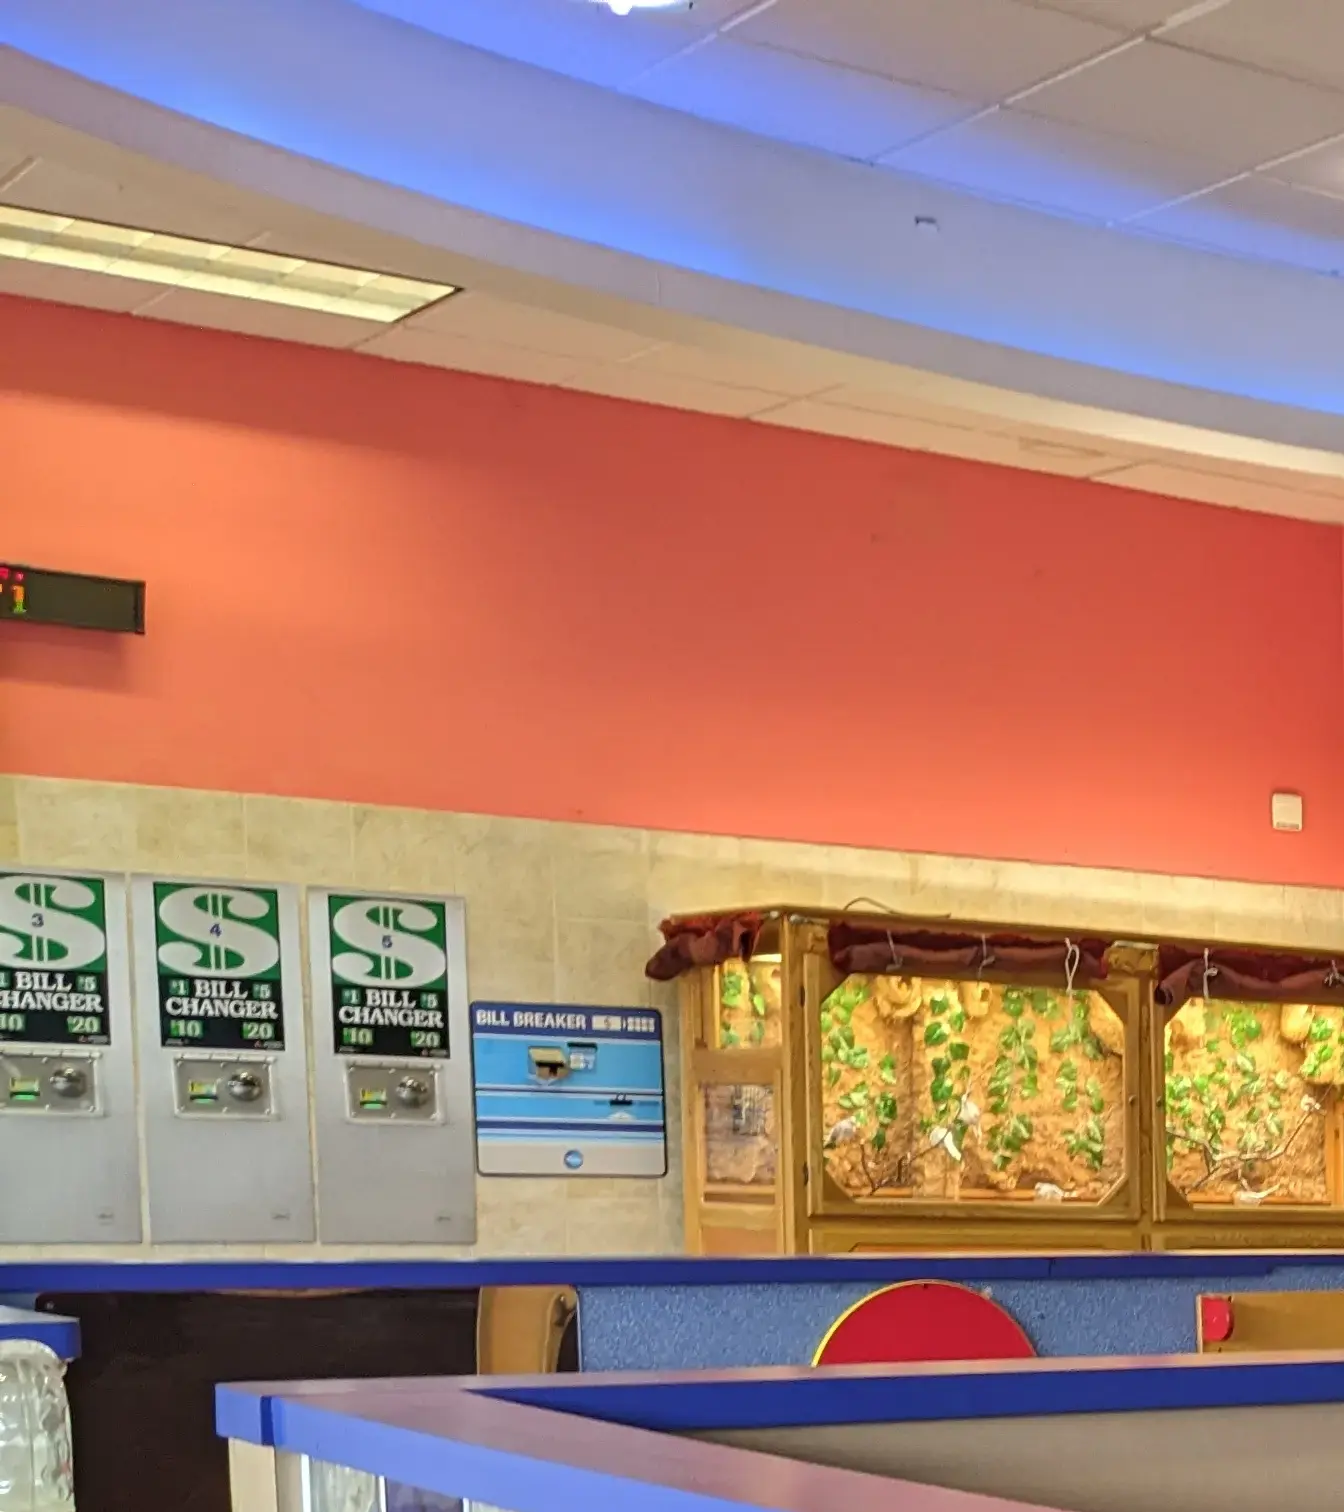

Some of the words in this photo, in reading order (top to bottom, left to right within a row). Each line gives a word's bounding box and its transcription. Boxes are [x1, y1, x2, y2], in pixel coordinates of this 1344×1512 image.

[31, 913, 44, 928] 3
[210, 923, 222, 938] 4
[15, 971, 73, 992] BILL
[194, 979, 249, 999] BILL
[0, 990, 104, 1013] HANGER
[165, 996, 278, 1020] CHANGER
[366, 988, 416, 1008] BILL
[338, 1006, 444, 1029] CHANGER
[476, 1009, 510, 1027] BILL
[513, 1011, 587, 1030] BREAKER
